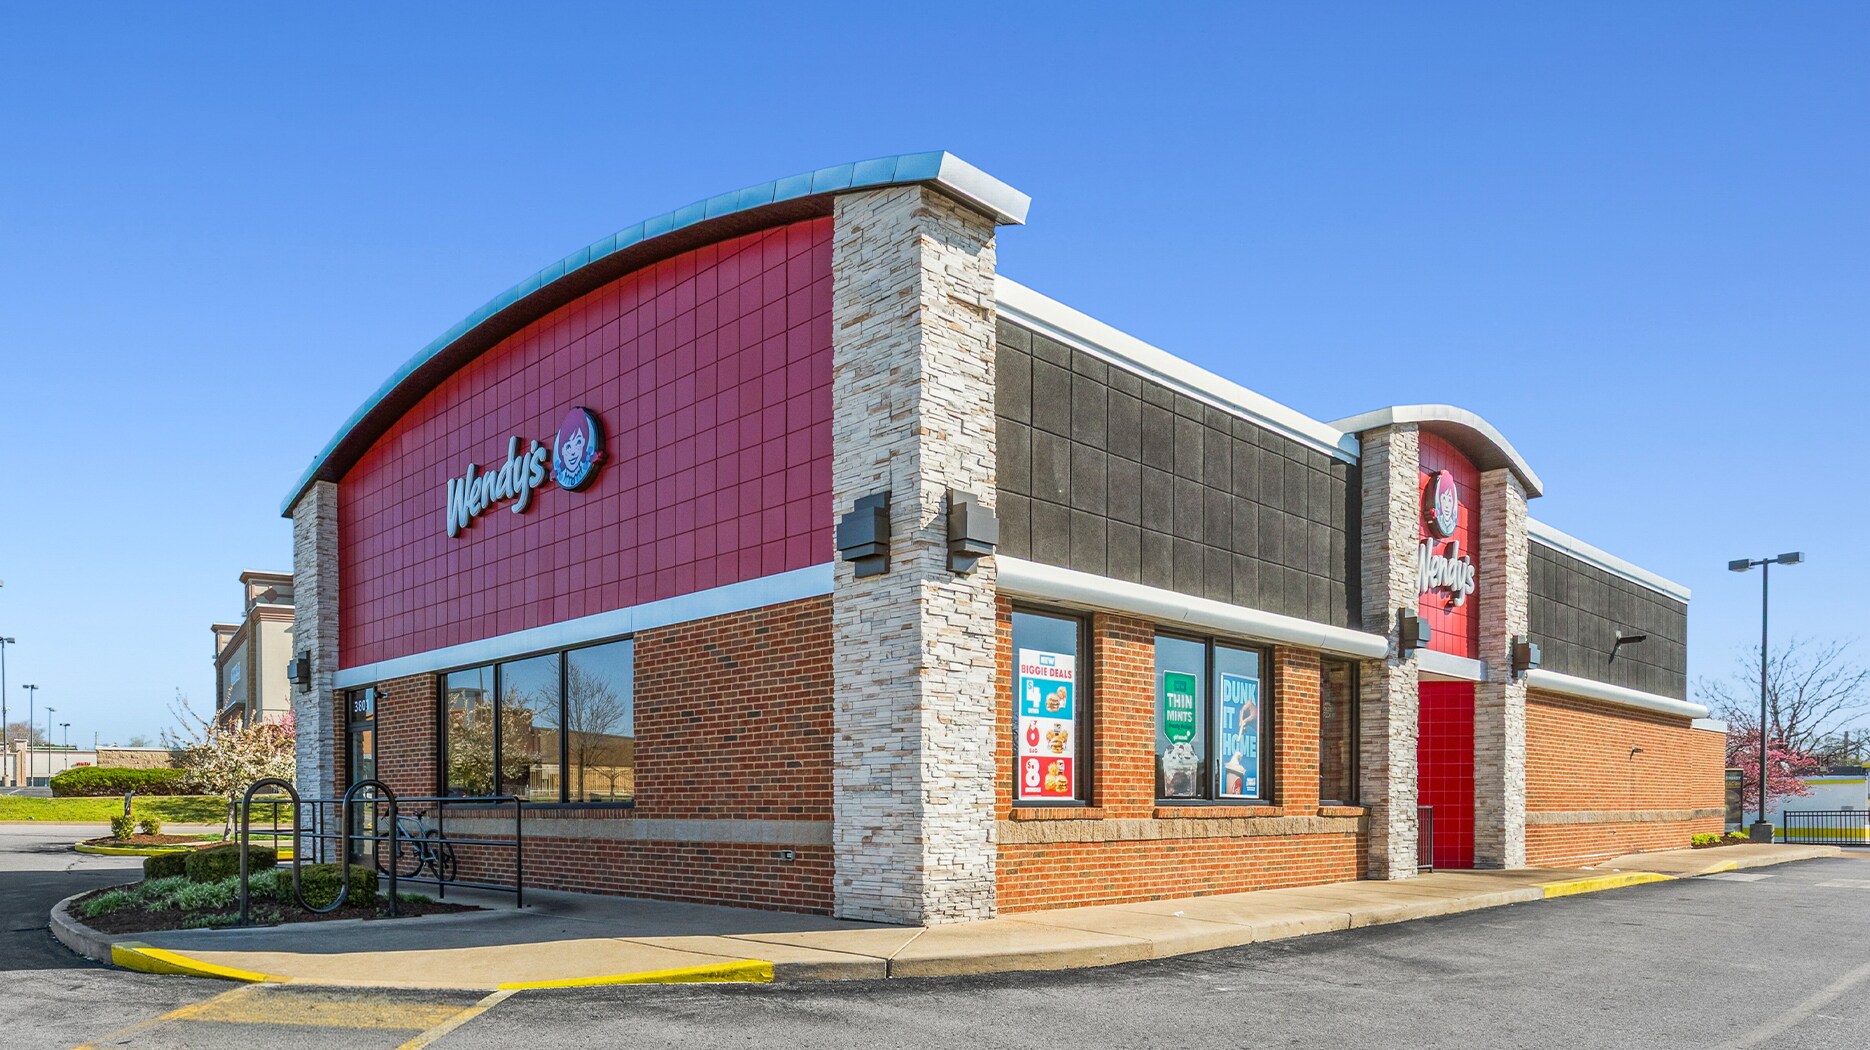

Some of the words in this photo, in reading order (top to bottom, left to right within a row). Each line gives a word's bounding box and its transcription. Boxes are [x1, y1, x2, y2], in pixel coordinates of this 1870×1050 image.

[447, 435, 548, 538] Wendy's
[1021, 665, 1047, 677] BIGGIE
[1049, 667, 1073, 679] DEALS
[1167, 693, 1193, 709] THIN
[1223, 680, 1257, 706] DUNK
[1167, 710, 1193, 723] MINTS
[1223, 706, 1235, 729] IT
[1223, 733, 1256, 758] HOME
